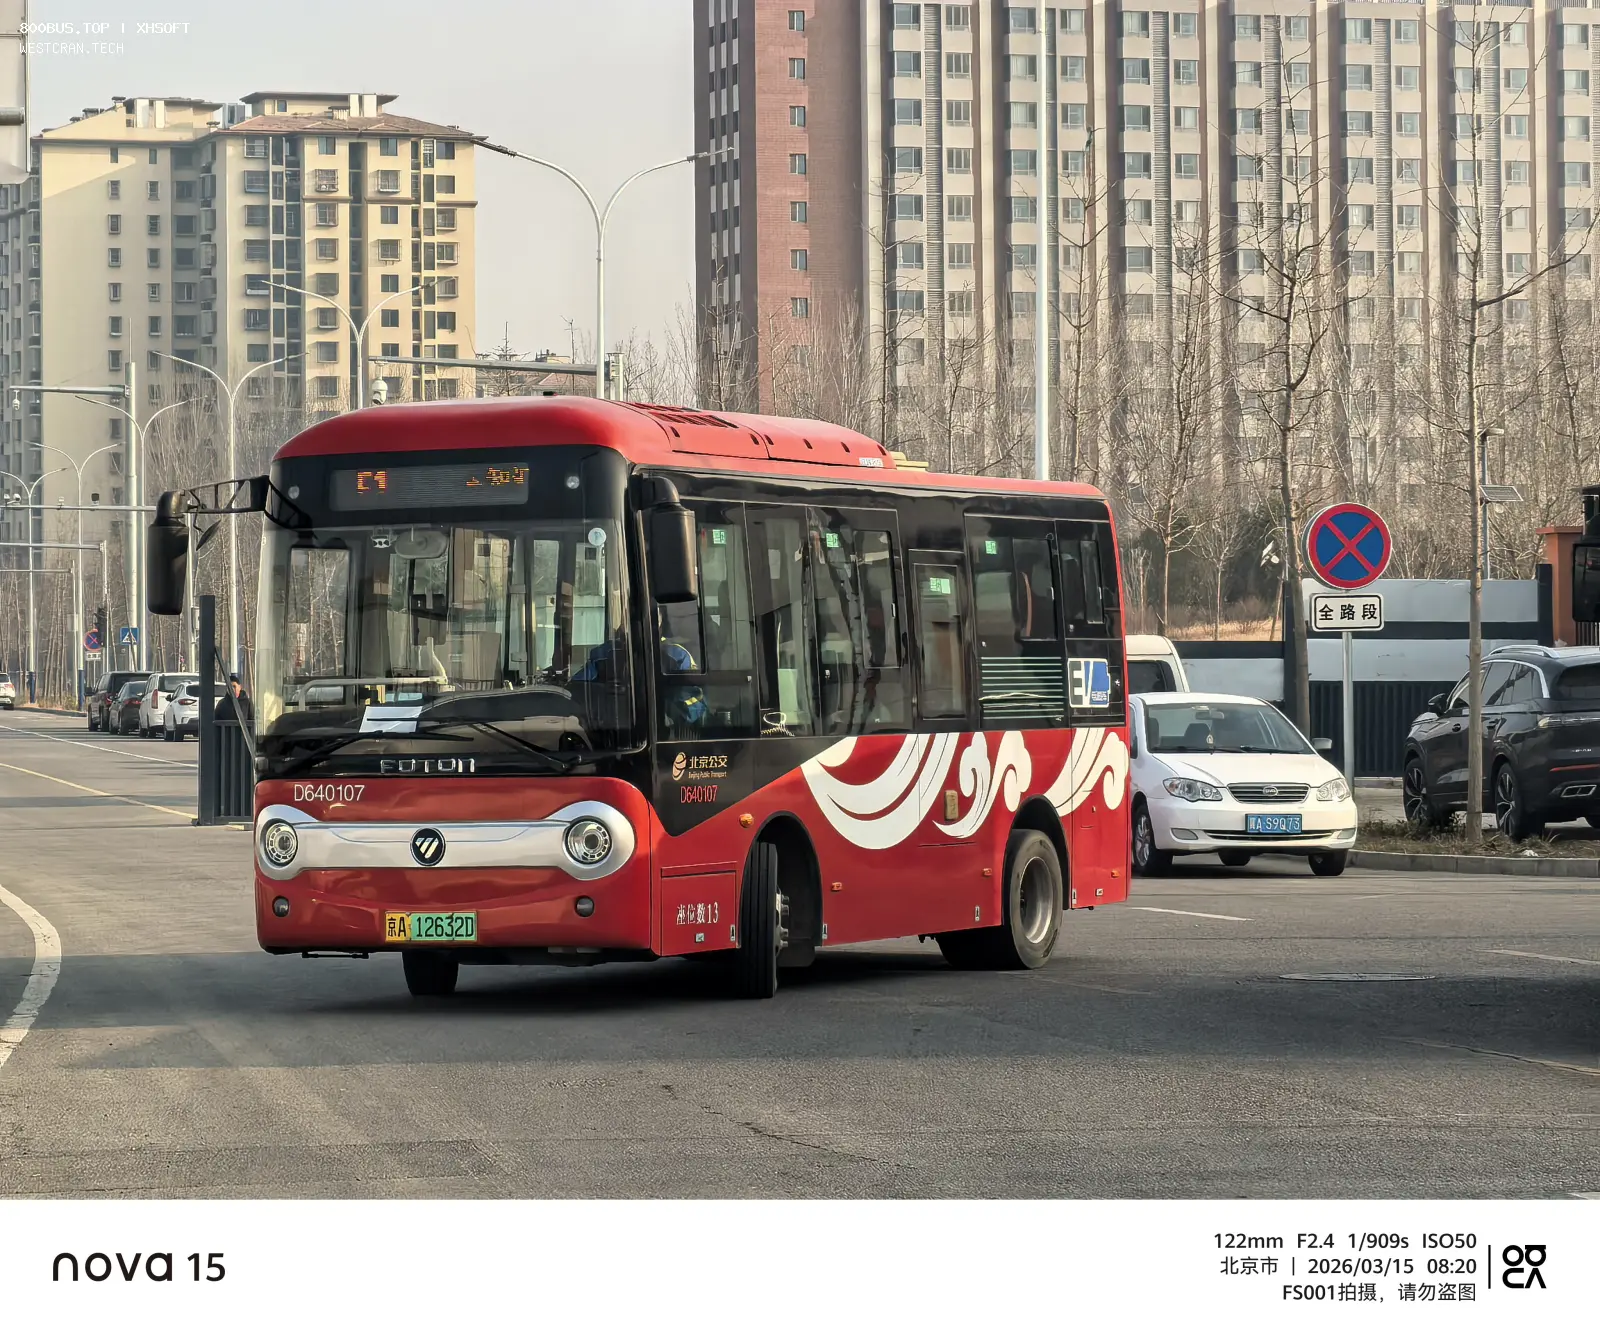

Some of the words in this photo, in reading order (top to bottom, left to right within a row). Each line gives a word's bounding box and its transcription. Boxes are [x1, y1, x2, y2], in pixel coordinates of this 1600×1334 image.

[1318, 603, 1378, 621] 全路段
[380, 757, 475, 773] FOTON
[689, 755, 728, 769] 北京公交
[294, 784, 365, 802] D640107
[680, 785, 718, 803] D640107
